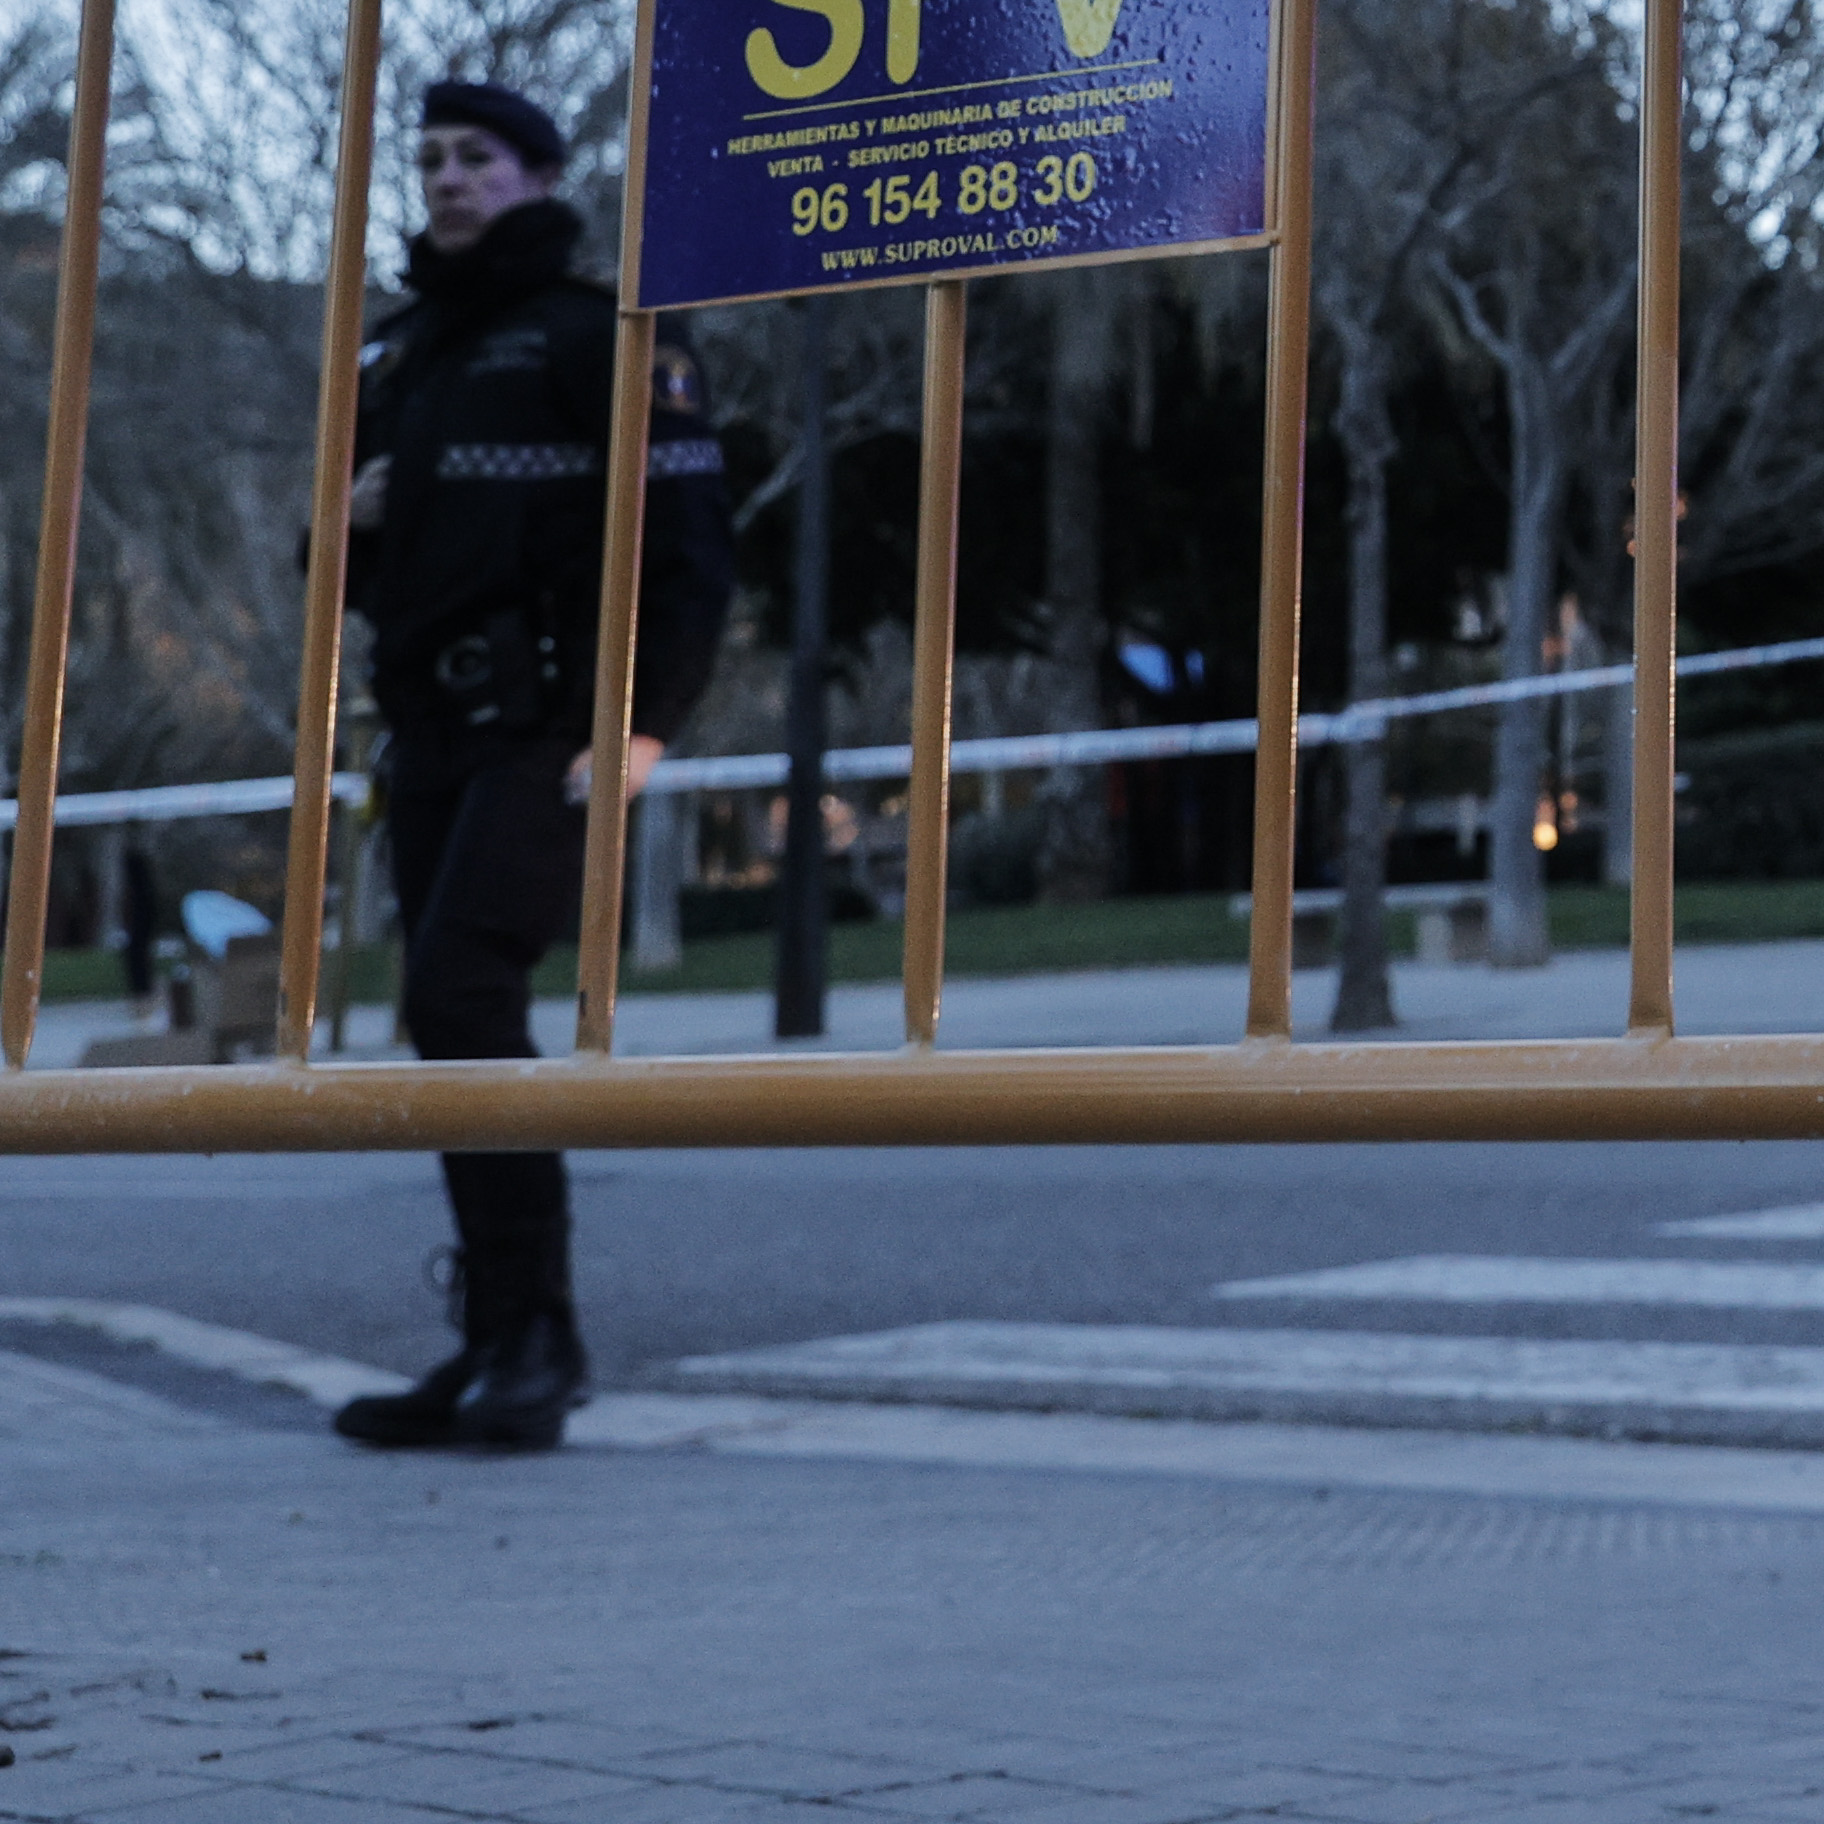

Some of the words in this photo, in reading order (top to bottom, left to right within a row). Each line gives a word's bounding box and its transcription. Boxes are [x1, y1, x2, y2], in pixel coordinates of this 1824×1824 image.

[727, 121, 860, 156] HERRAMIENTAS
[865, 119, 877, 137] Y
[881, 103, 993, 135] MAQUINARIA
[997, 98, 1022, 119] DE
[767, 154, 824, 178] VENTA
[847, 139, 930, 169] SERVICIO
[1018, 127, 1030, 145] Y
[1034, 115, 1127, 143] ALQUILER
[791, 182, 849, 237] 96
[863, 169, 942, 227] 154
[957, 160, 1018, 216] 88
[1033, 150, 1098, 206] 30
[820, 224, 1059, 272] WWW.SUPROVAL.COM
